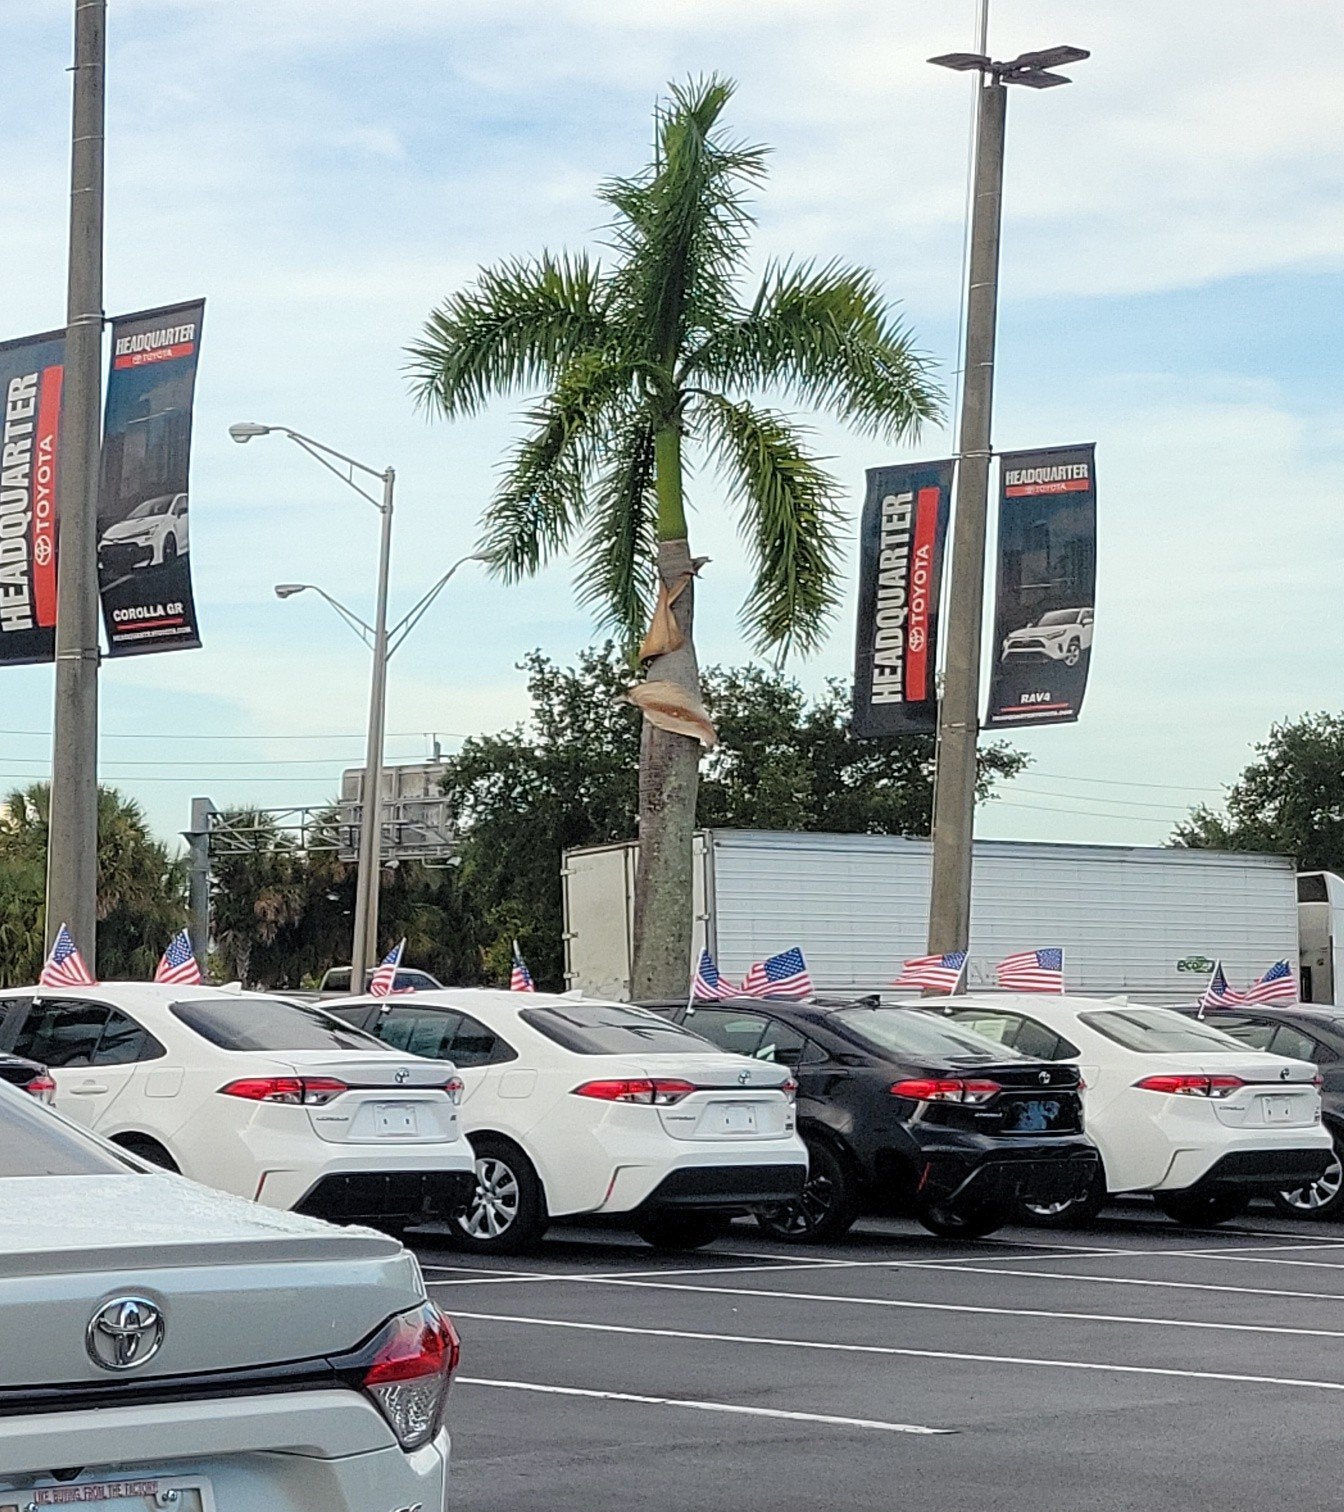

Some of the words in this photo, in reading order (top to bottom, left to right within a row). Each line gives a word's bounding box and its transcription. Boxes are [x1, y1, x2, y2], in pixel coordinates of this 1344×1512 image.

[116, 324, 195, 355] HEADQUARTER
[35, 435, 54, 532] TOYOTA
[1005, 464, 1088, 485] HEADQUARTER
[871, 491, 913, 705] HEADQUARTER
[912, 544, 930, 626] TOYOTA
[113, 604, 166, 621] COROLLA
[166, 602, 184, 614] GR
[1020, 692, 1050, 704] RAV4
